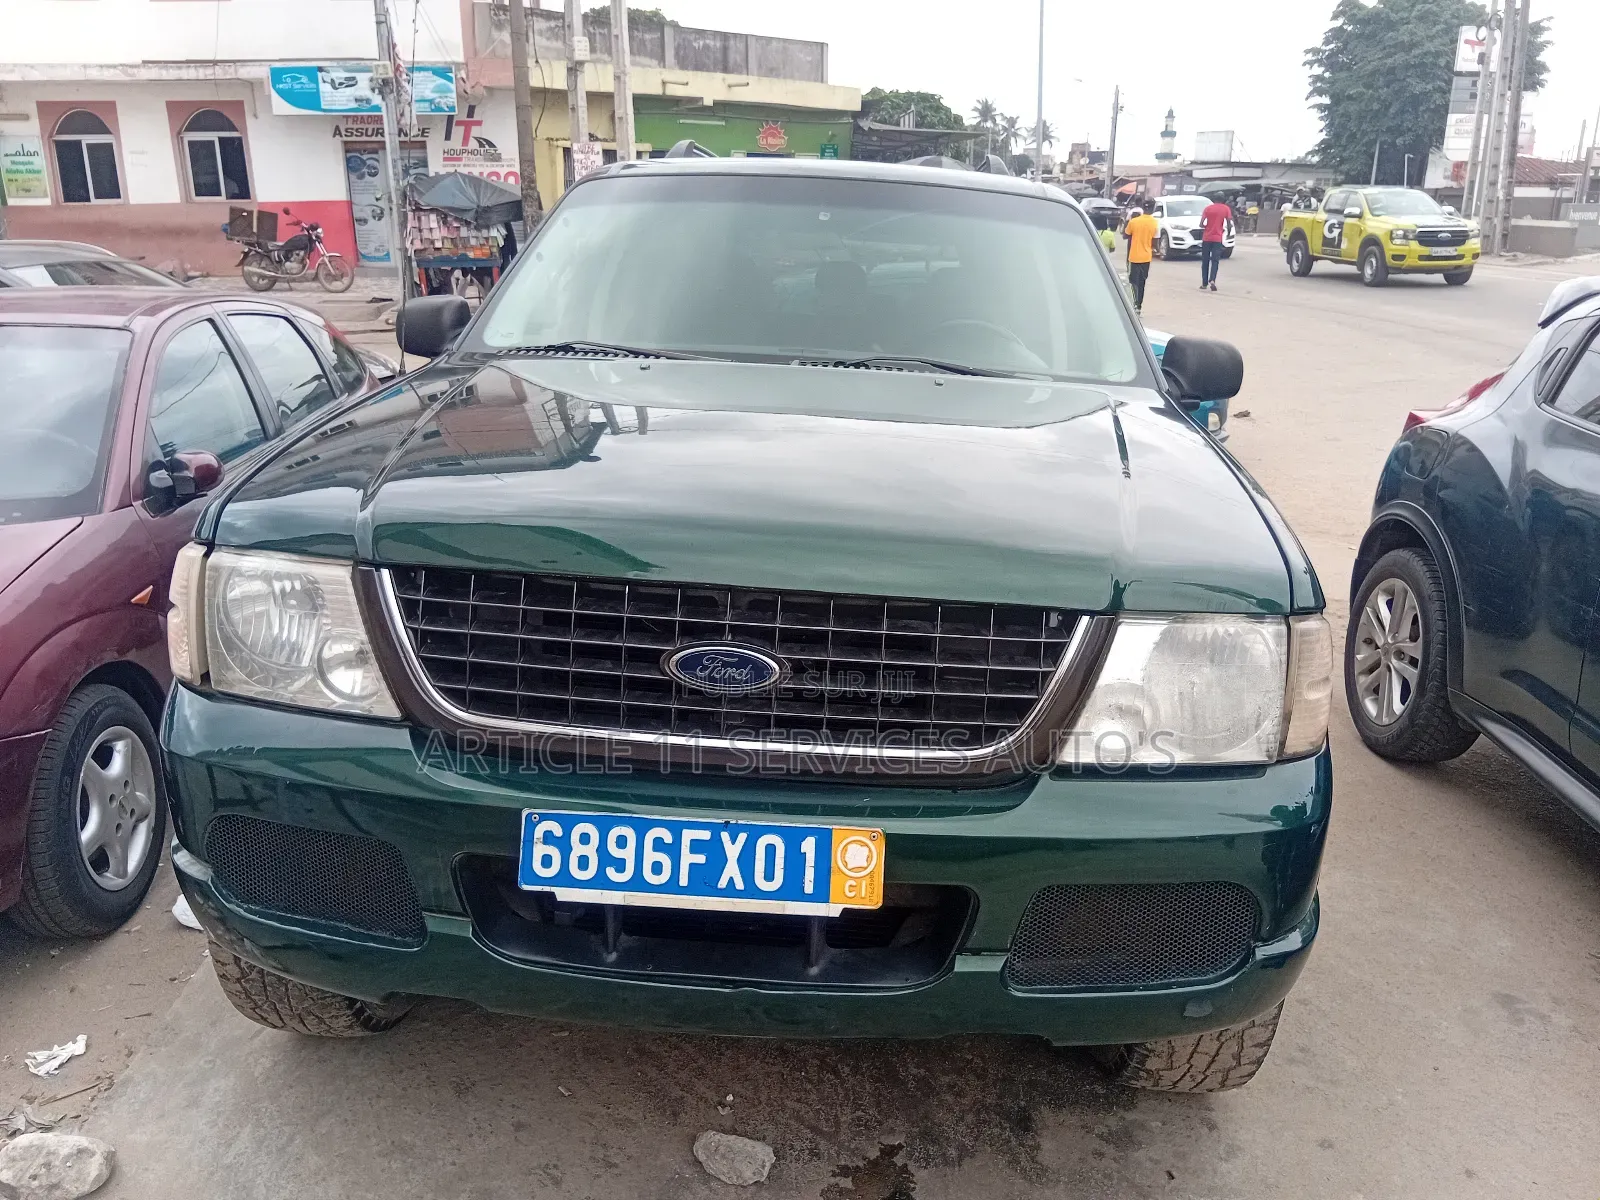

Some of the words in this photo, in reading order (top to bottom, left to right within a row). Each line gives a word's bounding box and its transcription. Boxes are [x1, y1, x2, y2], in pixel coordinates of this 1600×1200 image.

[696, 654, 752, 682] Ford
[531, 819, 818, 896] 6896FX01
[844, 879, 867, 899] CI
